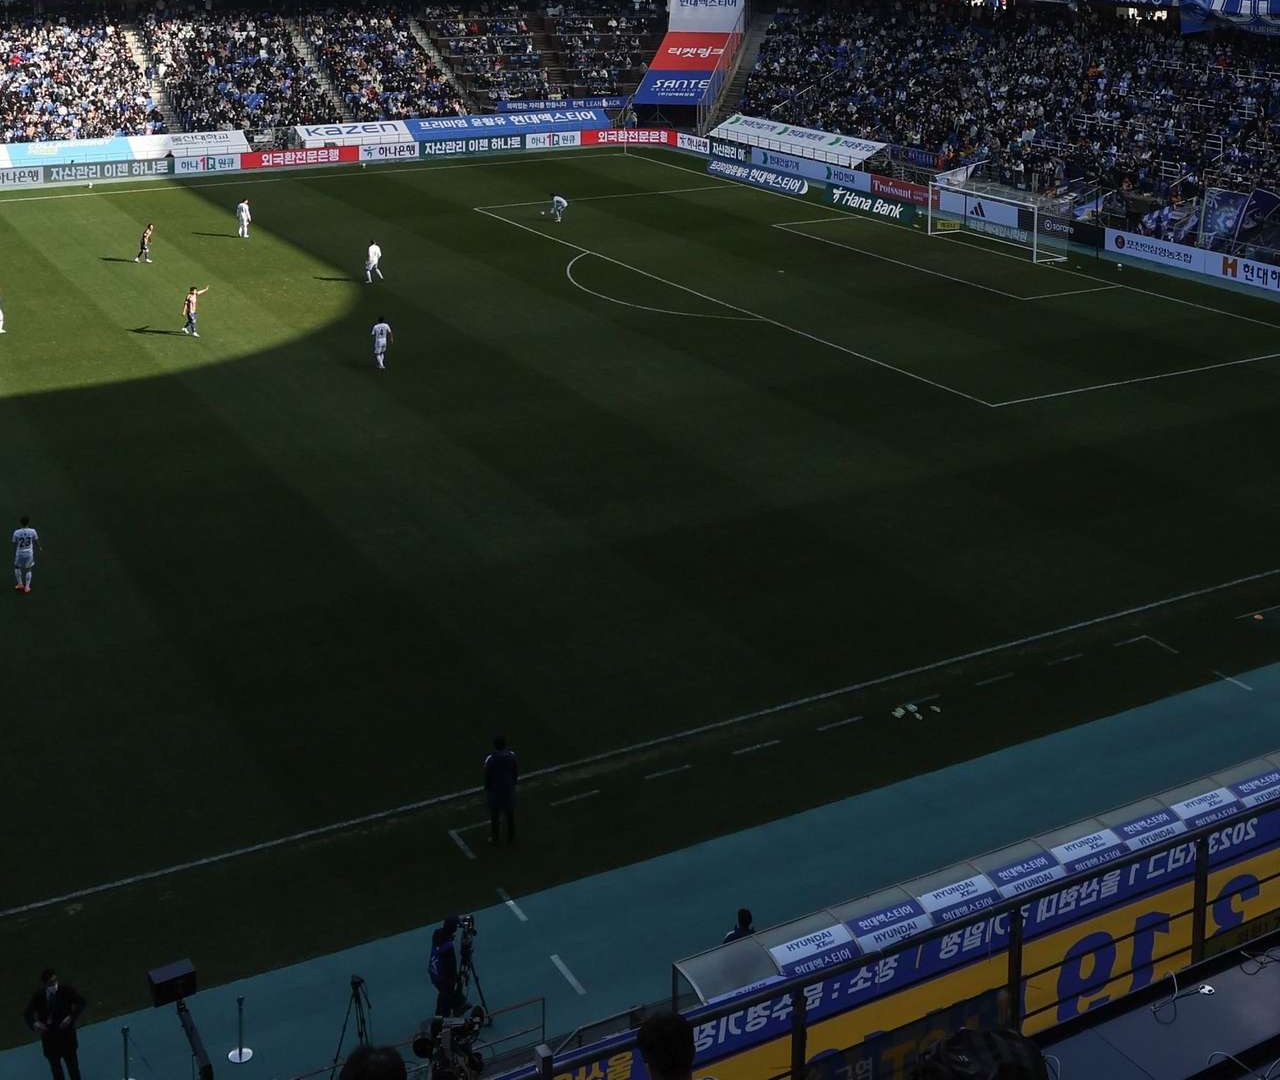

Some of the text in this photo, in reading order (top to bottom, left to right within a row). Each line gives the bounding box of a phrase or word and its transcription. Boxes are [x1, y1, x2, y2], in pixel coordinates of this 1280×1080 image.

[418, 118, 469, 130] 프리미엄
[509, 110, 598, 126] 현대엑스티어
[424, 135, 521, 155] 자산관리 이젠 하나로
[597, 129, 668, 145] 외국환전문은행
[686, 136, 708, 153] 하나은행
[199, 155, 216, 171] 1Q
[218, 157, 234, 169] 원큐
[261, 148, 340, 168] 외국환전문은행
[378, 144, 416, 161] 하나은행
[50, 159, 169, 181] 자산관리 이젠 하나로
[750, 168, 802, 194] 현대엑스티어
[842, 191, 904, 219] Hana Bank
[1183, 790, 1220, 809] HYUNDAI
[1063, 833, 1104, 854] HYUNDAI
[1139, 826, 1177, 846] HYUNDAI
[932, 879, 976, 900] HYUNDAI
[1013, 871, 1054, 893] HYUNDAI
[857, 904, 915, 931] 현대엑스티어
[941, 895, 994, 922] 현대엑스티어
[785, 929, 834, 952] HYUNDAI
[872, 921, 920, 944] HYUNDAI
[793, 947, 853, 976] 현대엑스티어
